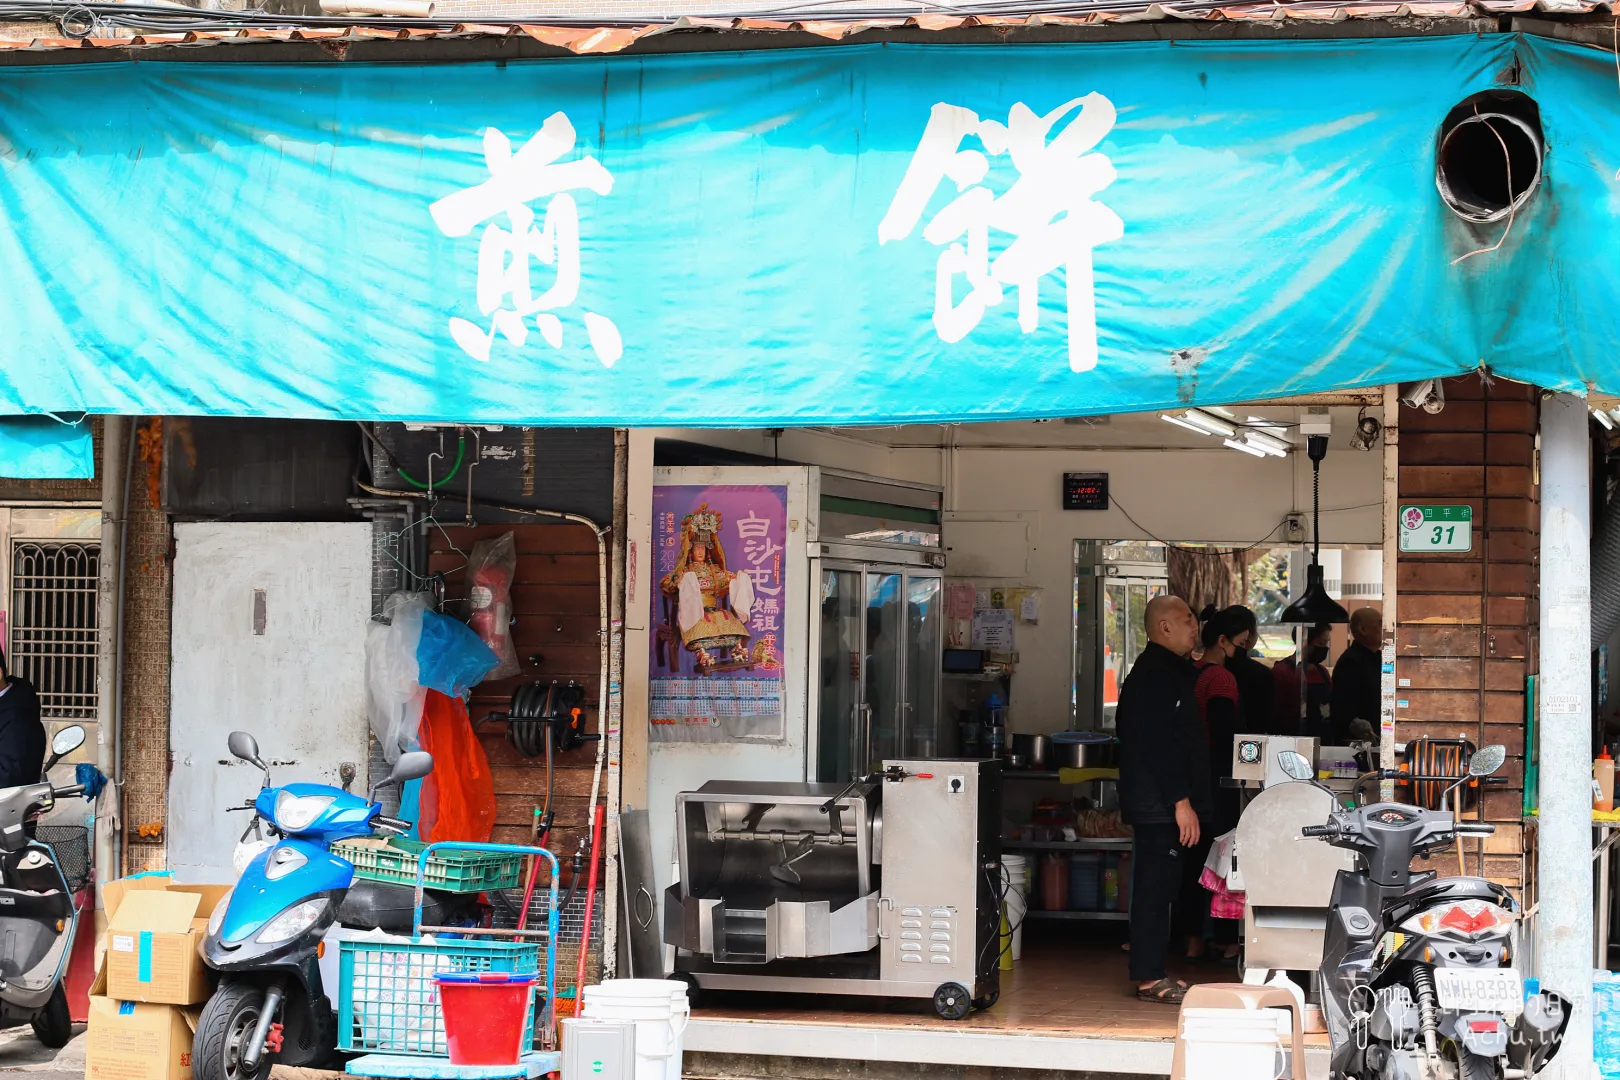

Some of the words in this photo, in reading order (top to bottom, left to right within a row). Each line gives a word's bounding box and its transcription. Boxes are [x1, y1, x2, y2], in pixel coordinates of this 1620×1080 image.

[430, 92, 1124, 373] 煎餅
[1425, 508, 1469, 519] 四平街
[1430, 525, 1455, 545] 31
[1548, 695, 1578, 704] 0102101
[1456, 882, 1477, 892] SYM
